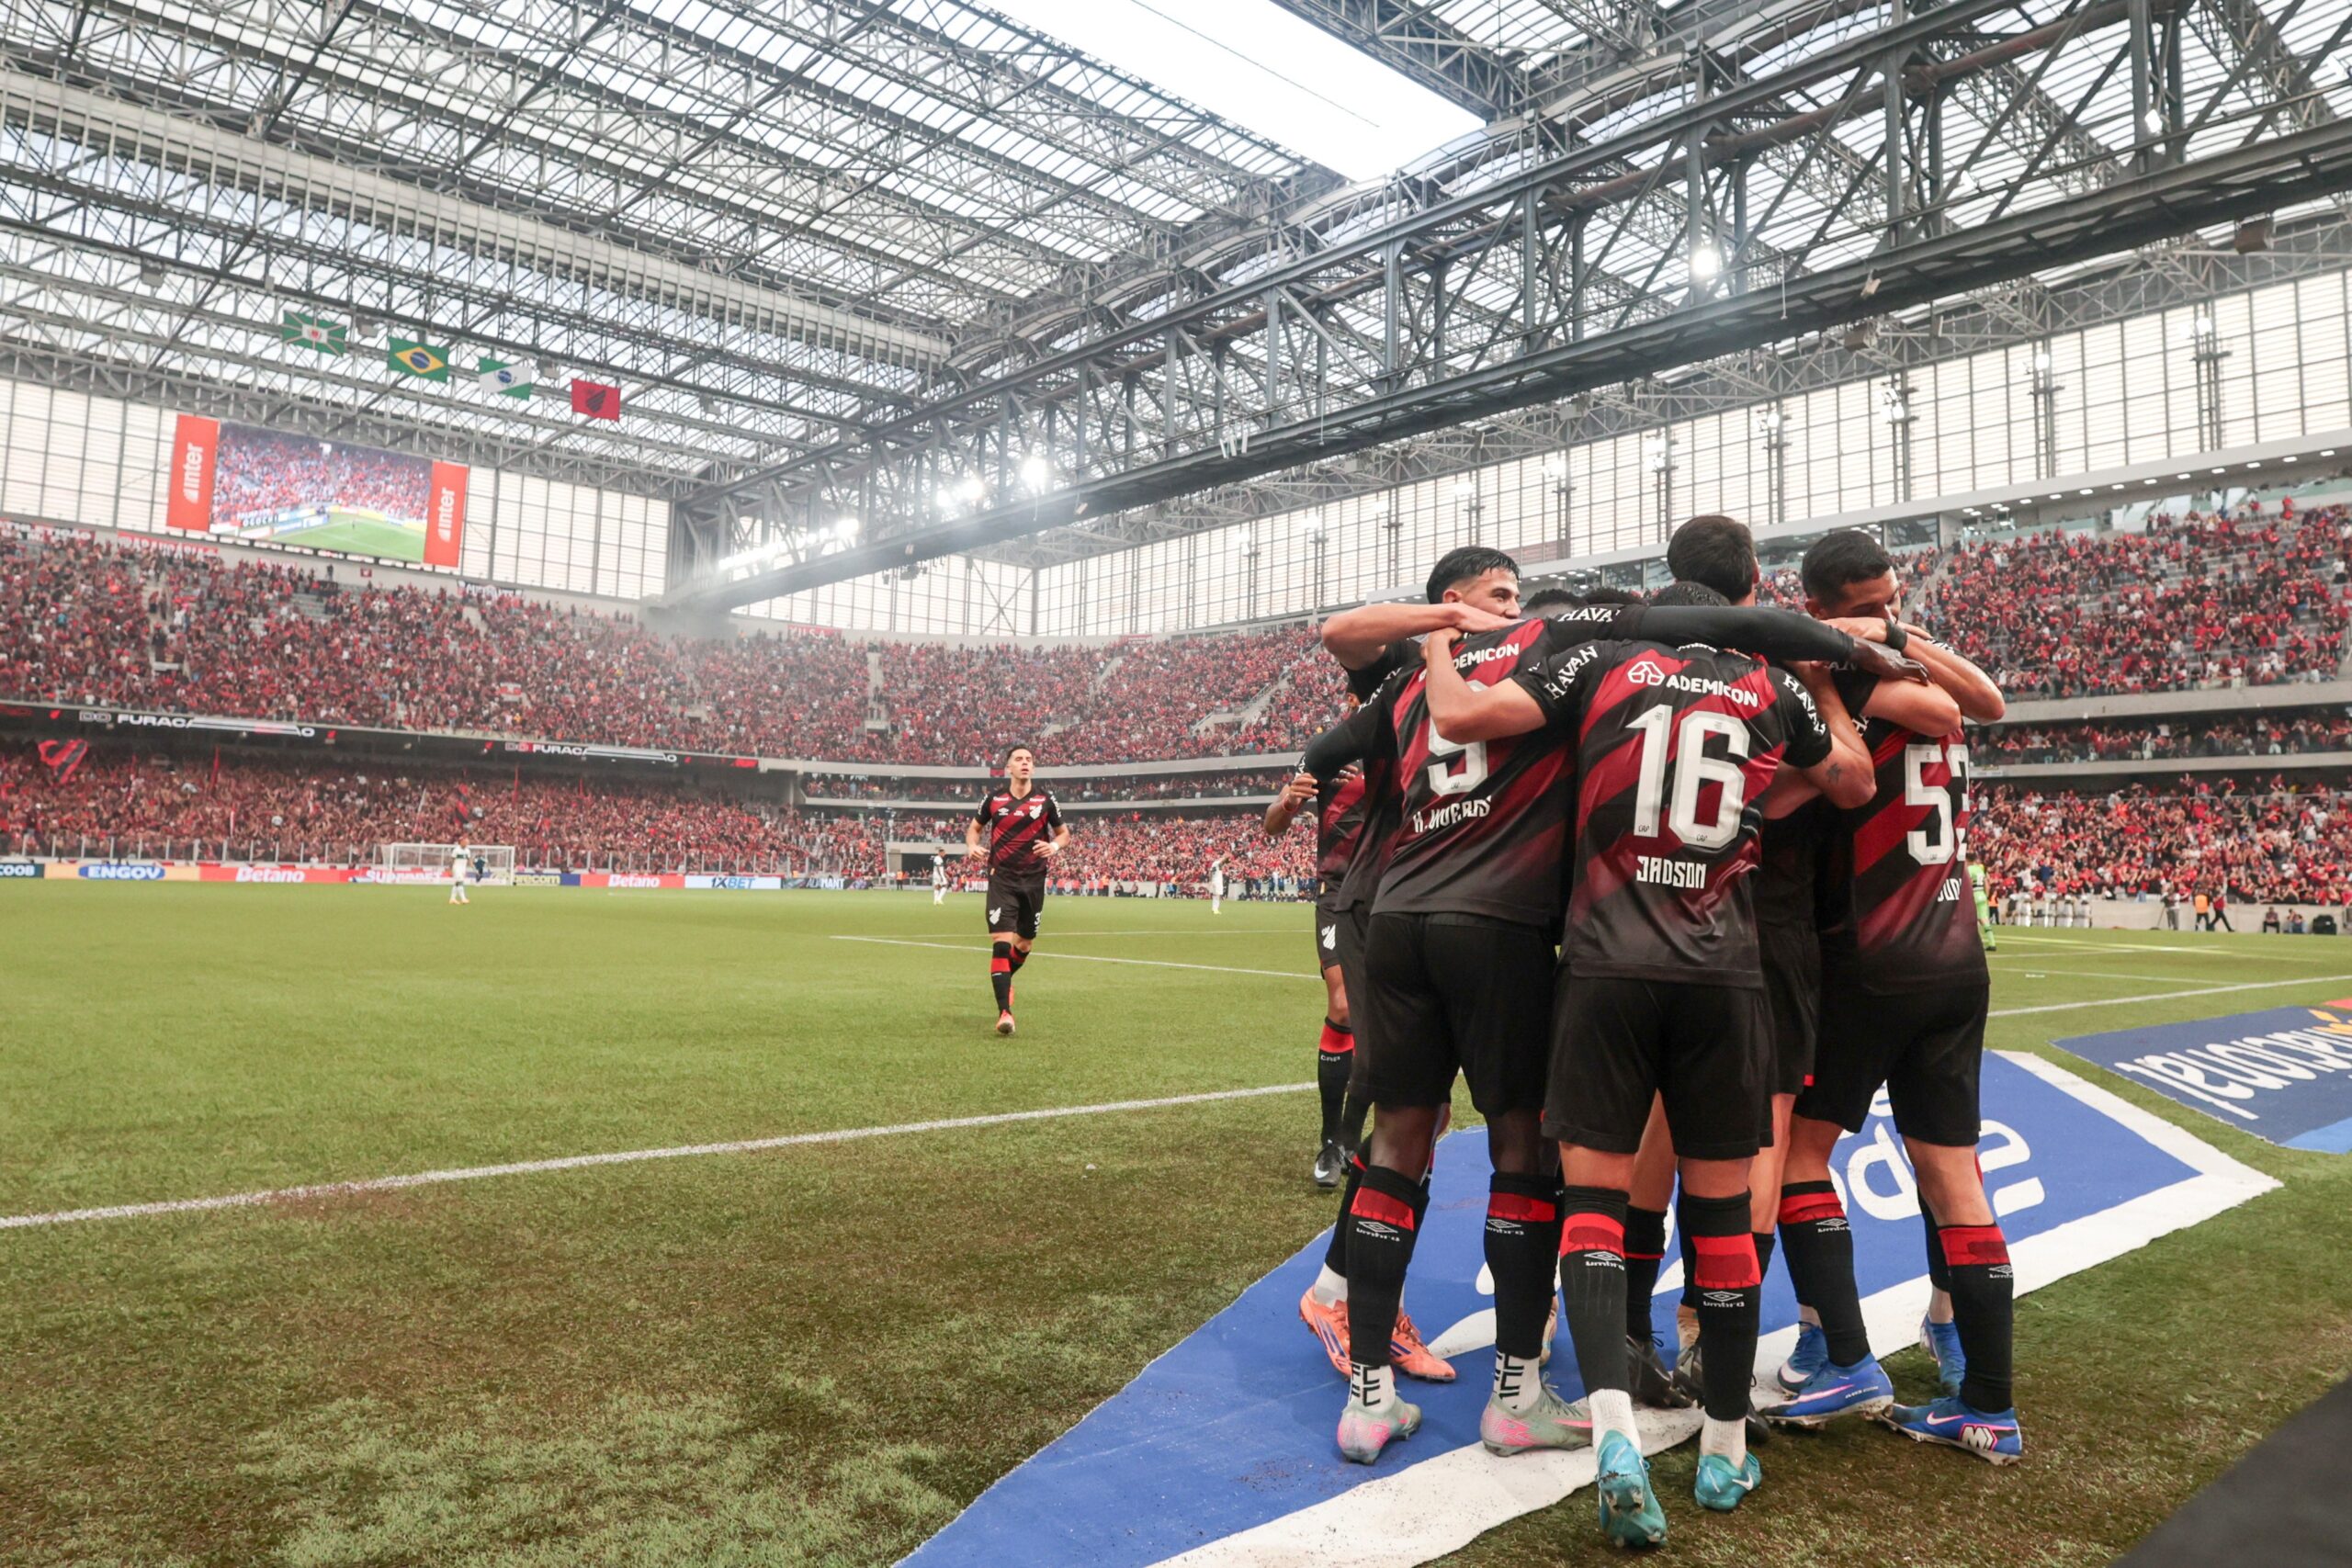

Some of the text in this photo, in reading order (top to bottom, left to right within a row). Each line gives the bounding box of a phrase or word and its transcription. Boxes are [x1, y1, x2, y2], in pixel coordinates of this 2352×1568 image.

[183, 442, 204, 491] inter
[438, 487, 456, 531] inter
[1557, 607, 1621, 623] HAVA
[1452, 643, 1521, 671] DEMICON
[1544, 645, 1599, 701] HAVAN
[1666, 674, 1758, 707] ADEMICON
[1625, 704, 1750, 850] 16
[86, 864, 162, 879] ENGOV
[235, 866, 306, 883] Betano
[607, 874, 661, 887] Betano
[711, 876, 755, 888] 1XBET
[1636, 855, 1707, 889] JADSON
